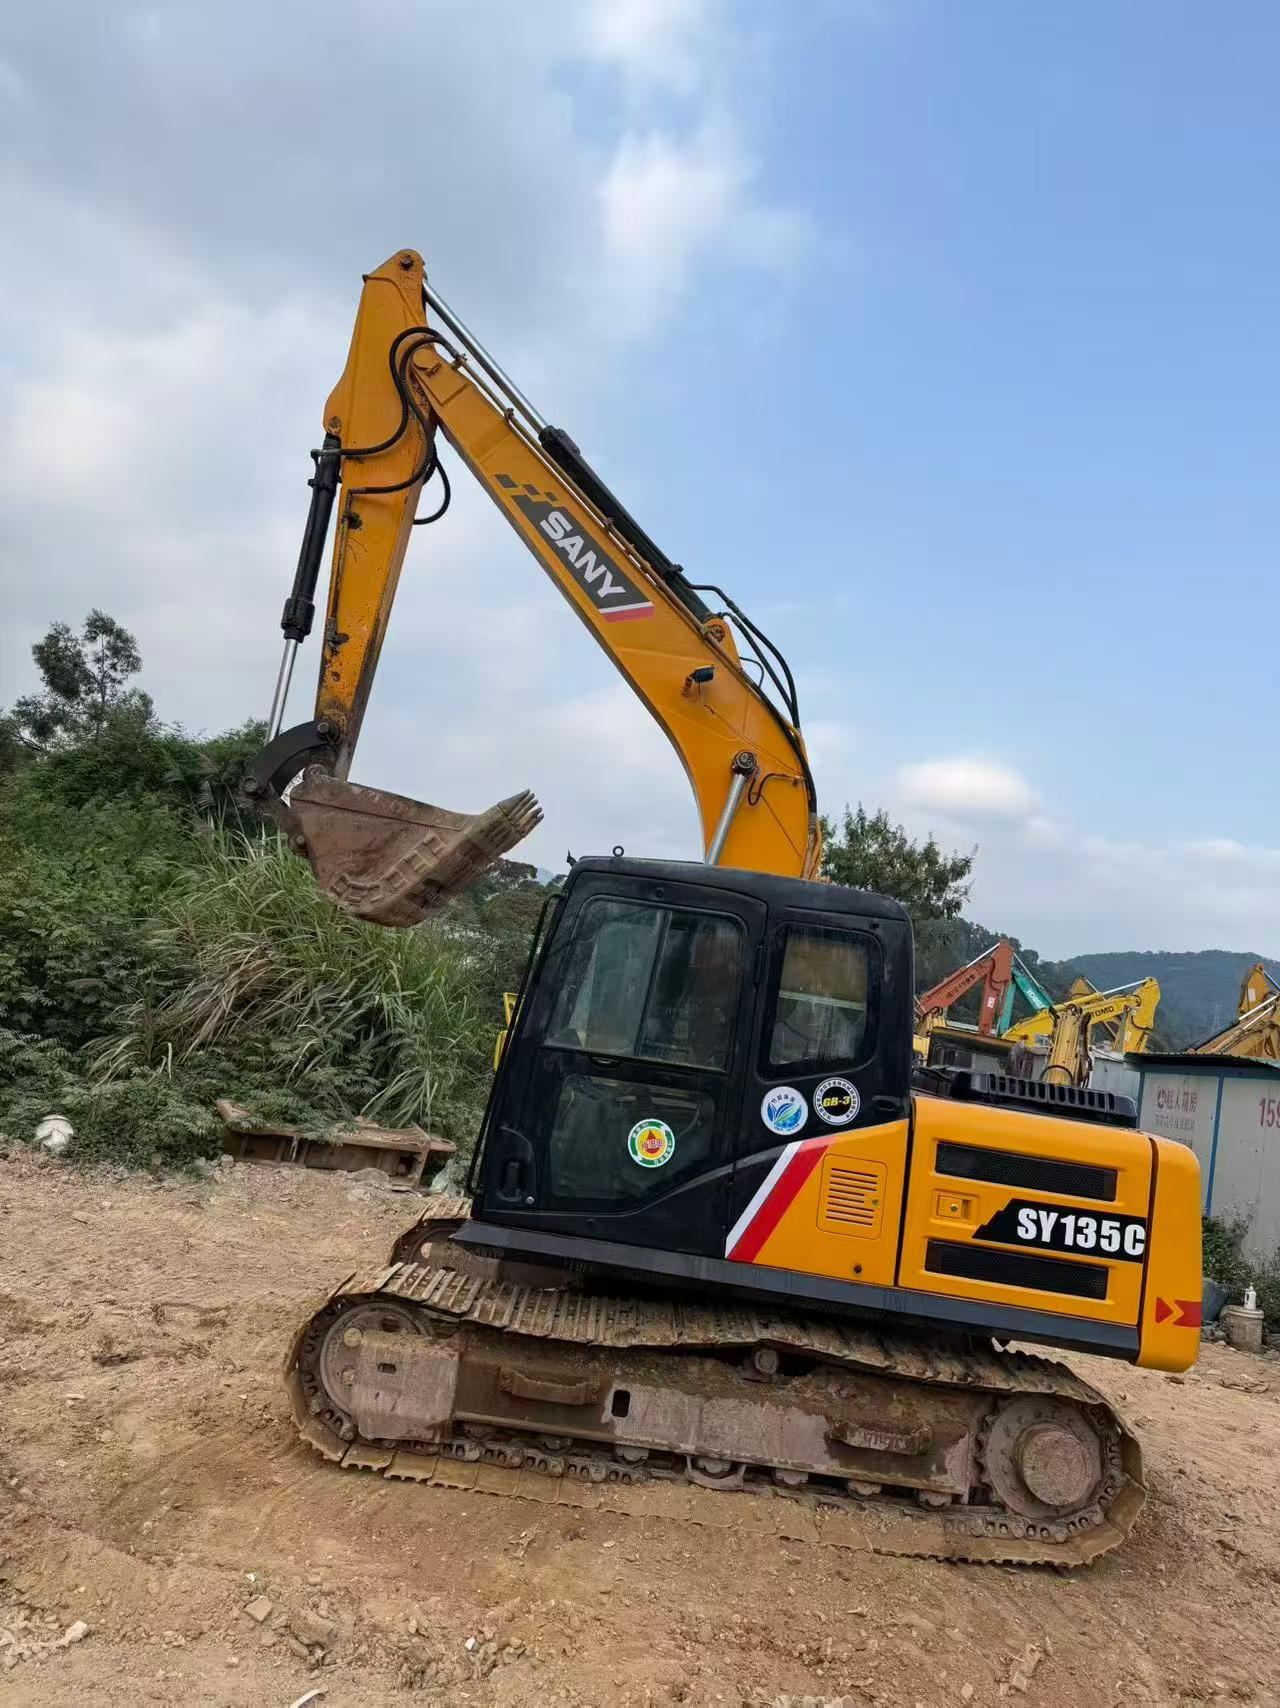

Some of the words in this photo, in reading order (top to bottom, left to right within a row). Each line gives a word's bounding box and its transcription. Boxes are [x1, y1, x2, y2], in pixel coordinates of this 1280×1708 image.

[539, 511, 626, 599] SANY
[1090, 1005, 1115, 1018] TOMO
[822, 1095, 851, 1107] GB-3
[1017, 1208, 1146, 1256] SY135C
